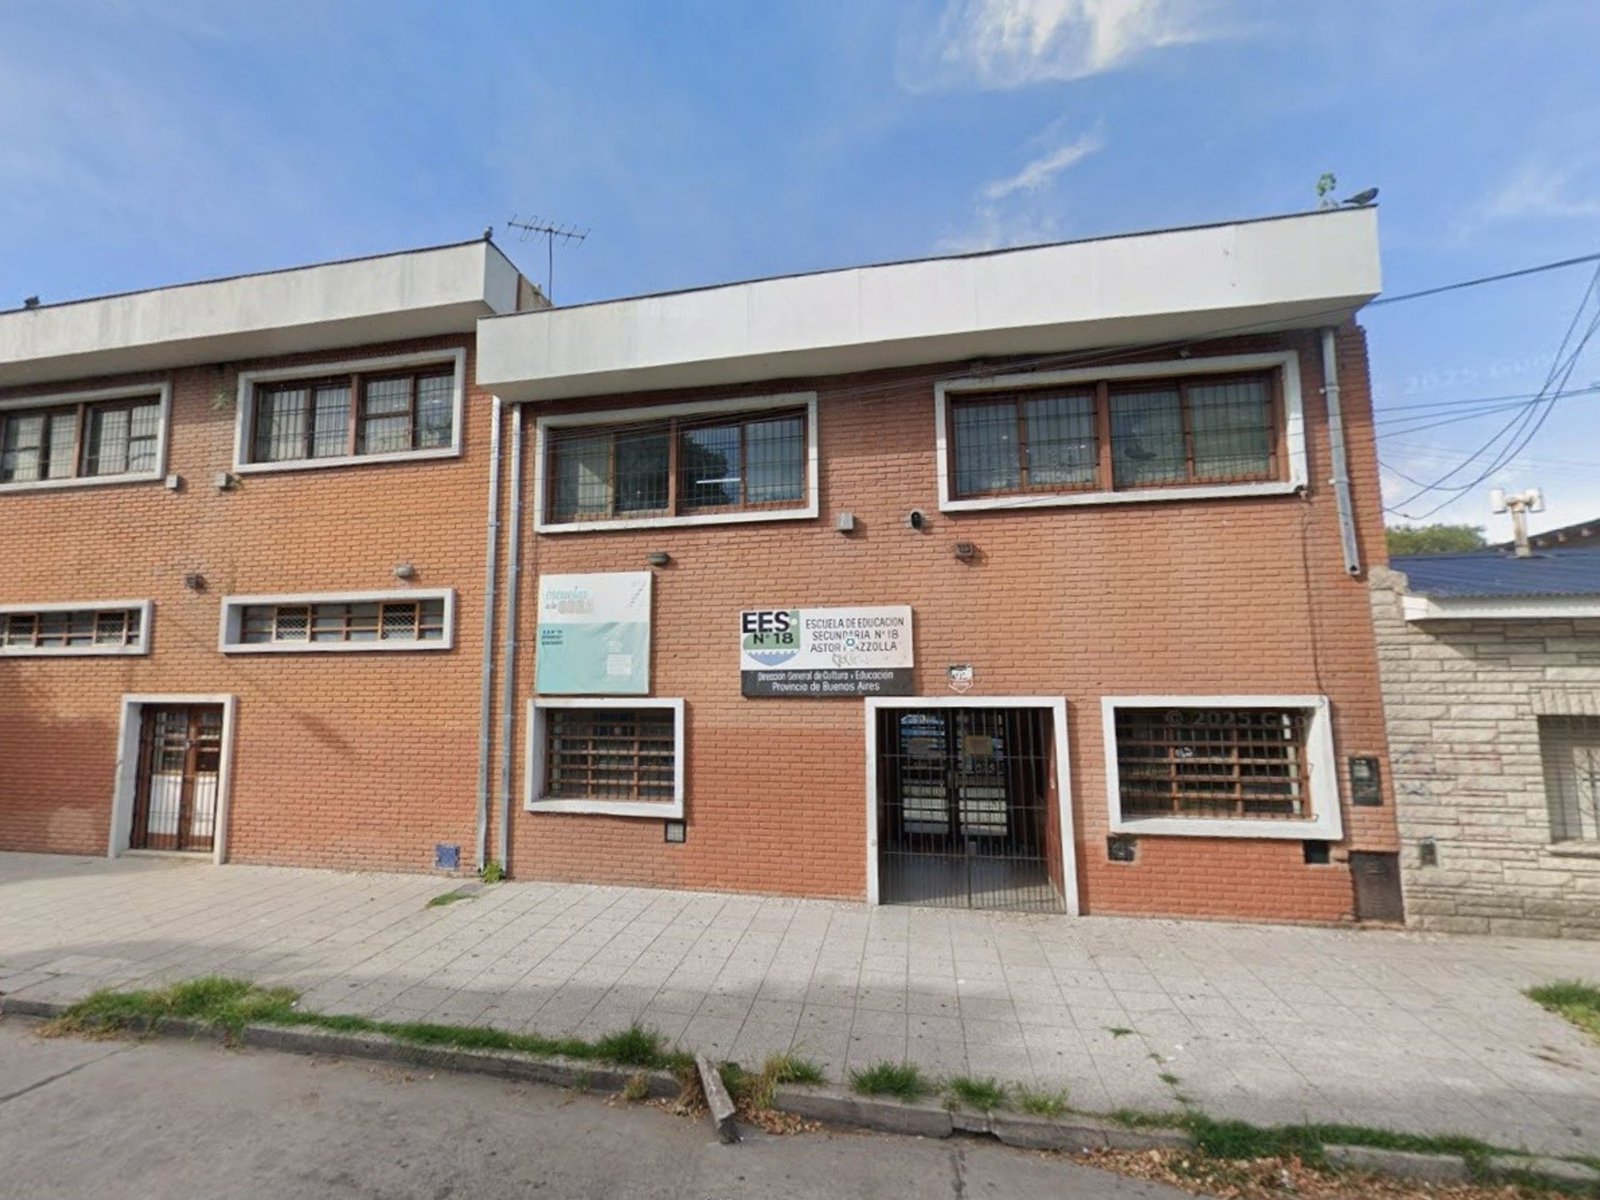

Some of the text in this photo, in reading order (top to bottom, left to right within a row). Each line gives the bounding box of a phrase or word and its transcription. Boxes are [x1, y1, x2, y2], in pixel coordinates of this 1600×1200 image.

[742, 612, 791, 634] EES
[805, 618, 845, 630] ESCUELA
[846, 618, 857, 629] DE
[775, 633, 794, 644] 18
[887, 629, 899, 640] 18
[810, 641, 898, 653] ASTOR AZZOLLA
[788, 671, 813, 681] General
[813, 671, 823, 681] de
[822, 670, 849, 681] Cultura
[771, 681, 880, 692] Provincia de Buenos Aires
